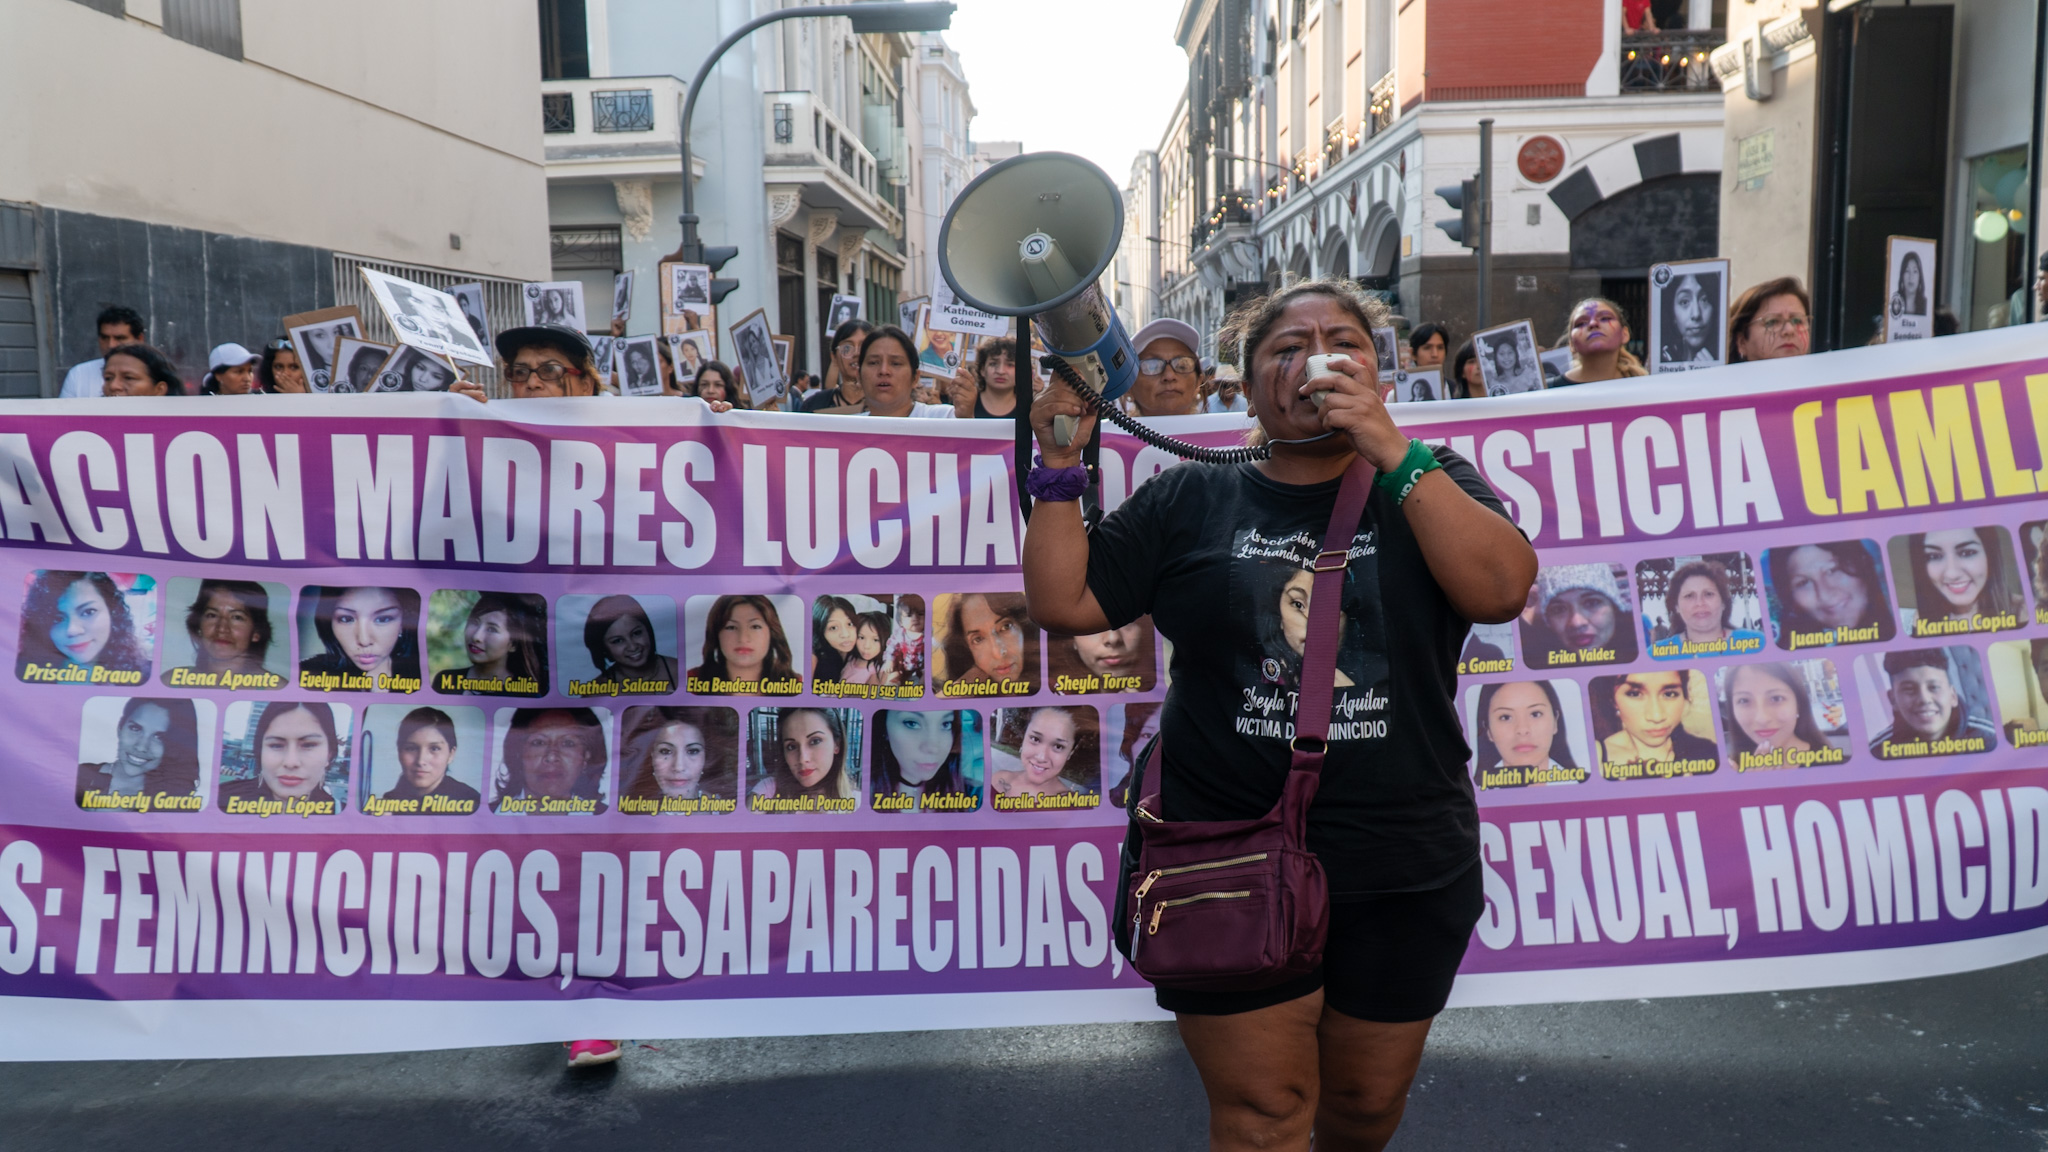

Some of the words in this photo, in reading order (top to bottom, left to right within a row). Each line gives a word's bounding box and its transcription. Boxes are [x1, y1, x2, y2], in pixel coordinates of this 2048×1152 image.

[950, 316, 986, 328] Gómez
[0, 431, 305, 560] ACION
[331, 434, 717, 569] MADRES
[1408, 407, 1783, 542] STICIA
[1243, 528, 1317, 549] Asociación
[1237, 544, 1302, 563] Luchando
[1302, 557, 1316, 569] po
[1917, 616, 1971, 636] Karina
[1972, 611, 2016, 633] Copia
[1653, 644, 1679, 656] karin
[1681, 639, 1727, 655] Alvarado
[1729, 637, 1760, 653] Lopez
[1789, 630, 1833, 651] Juana
[1836, 622, 1879, 641] Huari
[1469, 657, 1513, 673] Gomez
[1548, 649, 1576, 664] Erika
[1579, 649, 1615, 663] Valdez
[23, 663, 89, 682] Priscila
[90, 666, 142, 684] Bravo
[170, 668, 221, 687] Elena
[221, 669, 280, 691] Aponte
[300, 671, 340, 692] Evelyn
[342, 671, 373, 689] Lucía
[378, 673, 421, 694] Ordaya
[441, 674, 454, 690] M.
[456, 674, 502, 692] Fernanda
[505, 676, 538, 693] Guillén
[1056, 675, 1099, 694] Sheyla
[1102, 673, 1141, 690] Torres
[569, 680, 619, 697] Nathaly
[622, 678, 669, 692] Salazar
[686, 677, 709, 692] Elsa
[711, 677, 758, 693] Bendezu
[760, 677, 802, 694] Conislla
[812, 679, 869, 698] Esthefanny
[870, 684, 878, 699] y
[879, 685, 896, 698] sus
[897, 683, 924, 698] niñas
[942, 679, 998, 697] Gabriela
[1001, 679, 1029, 695] Cruz
[1243, 686, 1285, 716] Sheyla
[1335, 688, 1389, 719] Aguilar
[1235, 716, 1281, 738] VICTIMA
[1883, 738, 1928, 757] Fermin
[1931, 736, 1985, 754] soberon
[2013, 728, 2048, 749] Jhon
[1603, 759, 1642, 778] Yenni
[1646, 757, 1716, 778] Cayetano
[1739, 747, 1782, 772] Jhoeli
[1786, 746, 1843, 767] Capcha
[1481, 768, 1522, 791] Judith
[1525, 766, 1585, 783] Machaca
[82, 790, 151, 813] Kimberly
[154, 791, 202, 809] García
[227, 796, 283, 817] Evelyn
[285, 795, 334, 818] López
[363, 795, 418, 816] Aymee
[421, 795, 475, 812] Pillaca
[501, 796, 537, 812] Doris
[539, 795, 597, 812] Sanchez
[618, 795, 659, 815] Marleny
[660, 795, 698, 816] Atalaya
[700, 795, 736, 811] Briones
[752, 794, 814, 811] Marianella
[816, 796, 855, 811] Porroa
[872, 793, 914, 810] Zaida
[920, 793, 978, 809] Michilot
[994, 793, 1034, 810] Fiorella
[0, 839, 62, 975] S:
[1476, 810, 1739, 951] SEXUAL,
